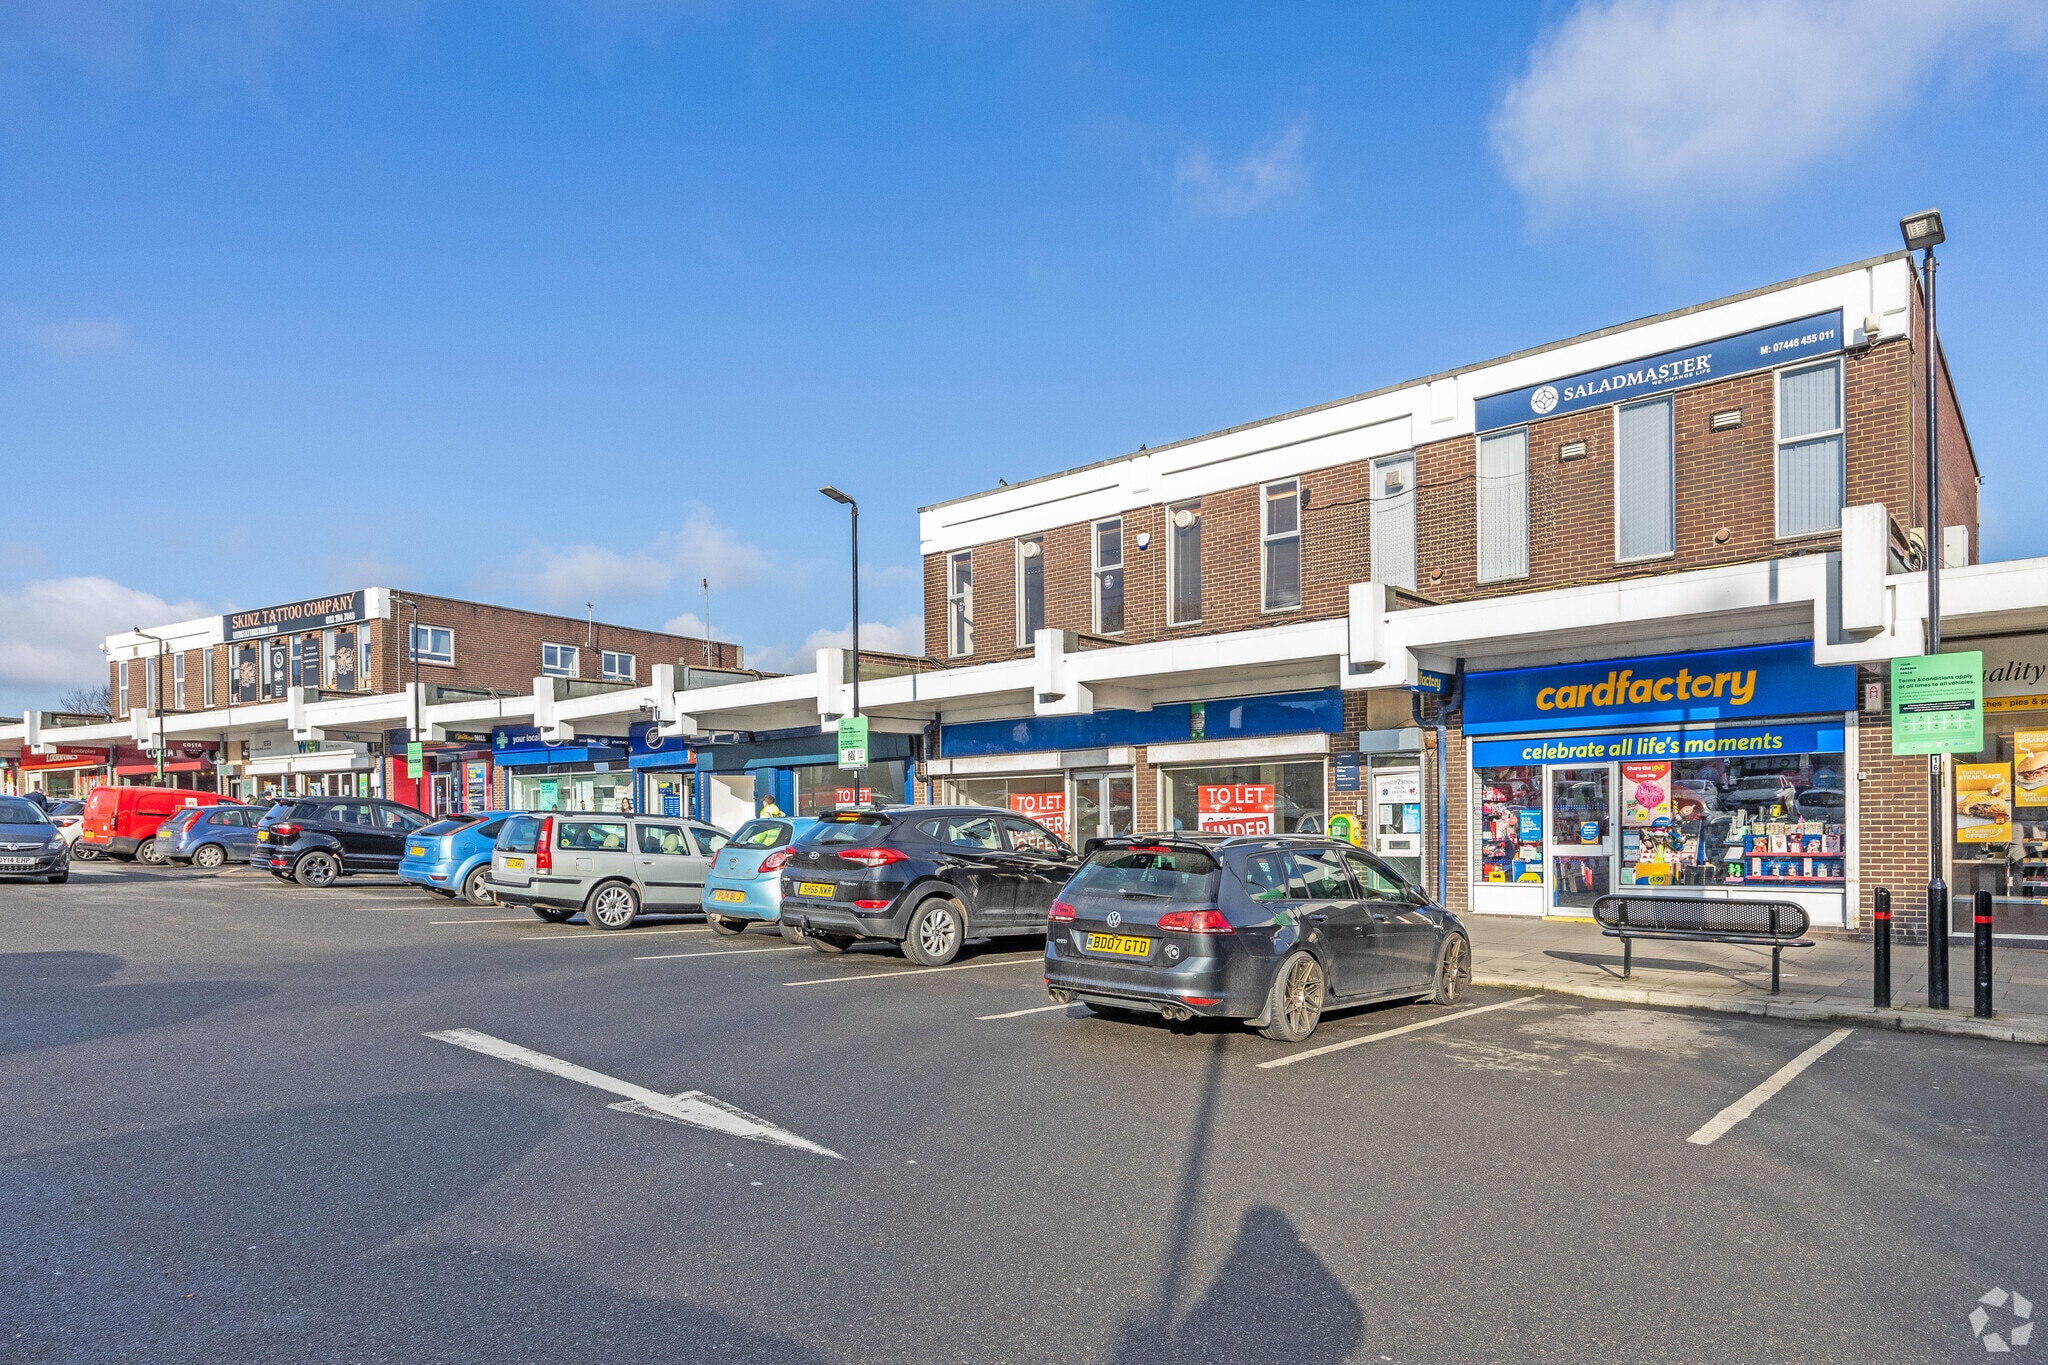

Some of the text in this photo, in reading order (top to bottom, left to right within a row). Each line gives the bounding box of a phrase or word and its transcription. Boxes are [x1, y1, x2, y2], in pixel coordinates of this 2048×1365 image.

[1760, 329, 1834, 355] M: 07446 455 011
[1563, 354, 1711, 401] SALADMASTER
[1652, 368, 1711, 386] WE CHANGE LIFE
[232, 592, 356, 629] SKINZ TATTOO COMPANY
[1418, 671, 1441, 692] factory
[1536, 668, 1757, 711] cardfactory
[2010, 699, 2028, 707] pies
[512, 734, 540, 744] your local
[1522, 733, 1782, 760] celebrate all life's moments
[146, 749, 174, 758] COTA
[838, 790, 851, 802] TO
[1016, 795, 1062, 810] TO LET
[1206, 787, 1266, 804] TO LET
[803, 884, 819, 894] SH66
[1093, 936, 1147, 953] BD07 GTD
